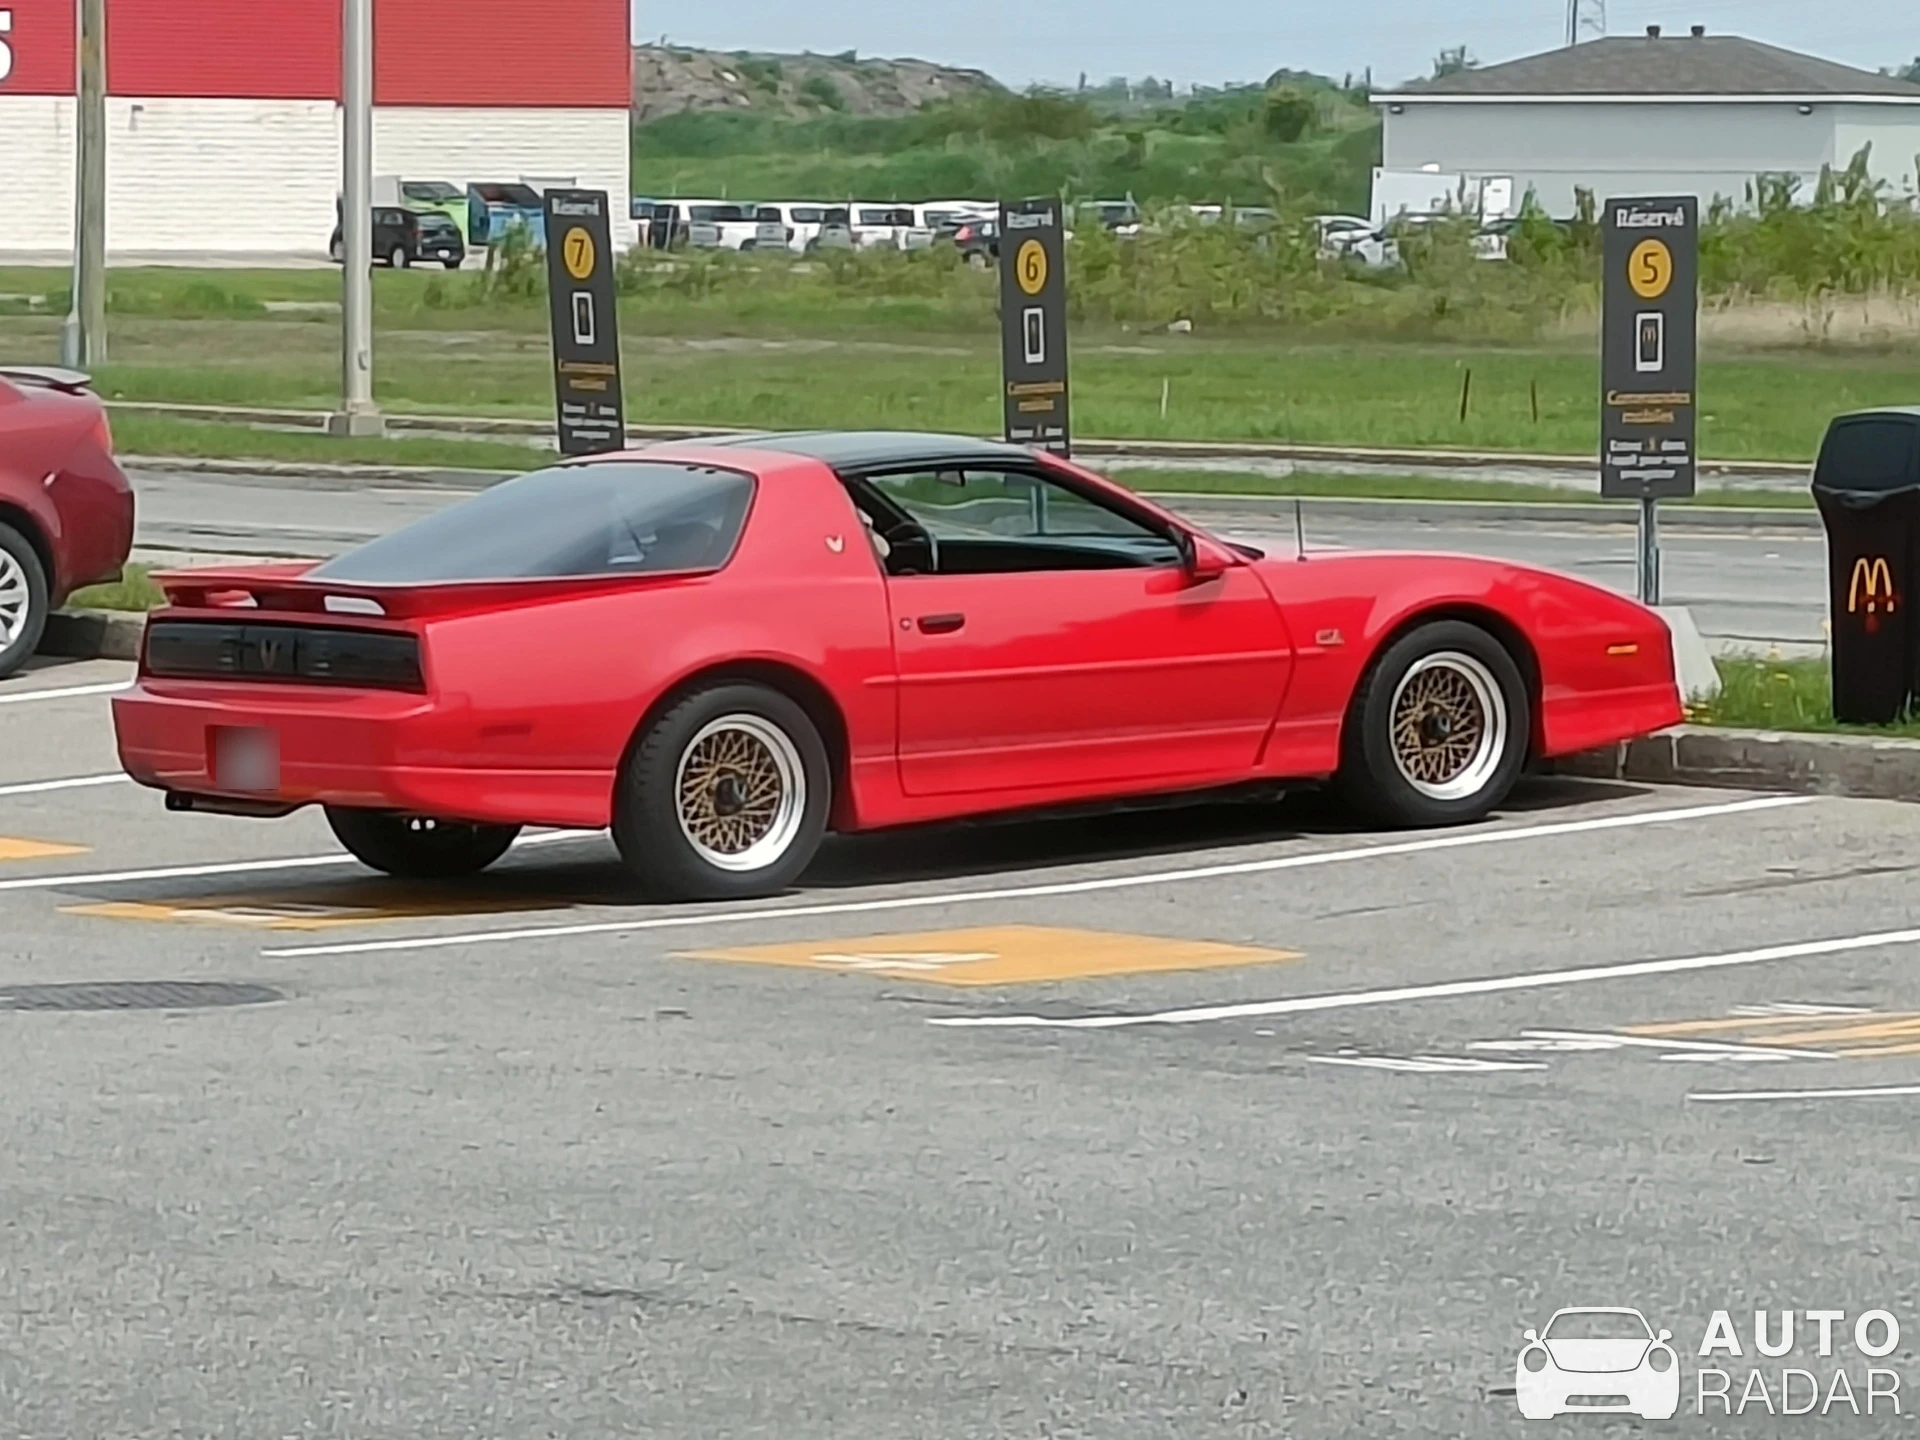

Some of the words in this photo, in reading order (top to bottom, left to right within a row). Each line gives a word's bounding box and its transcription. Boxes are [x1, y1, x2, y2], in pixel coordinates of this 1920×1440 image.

[572, 238, 585, 268] 7
[1026, 251, 1039, 282] 6
[1641, 252, 1659, 284] 5
